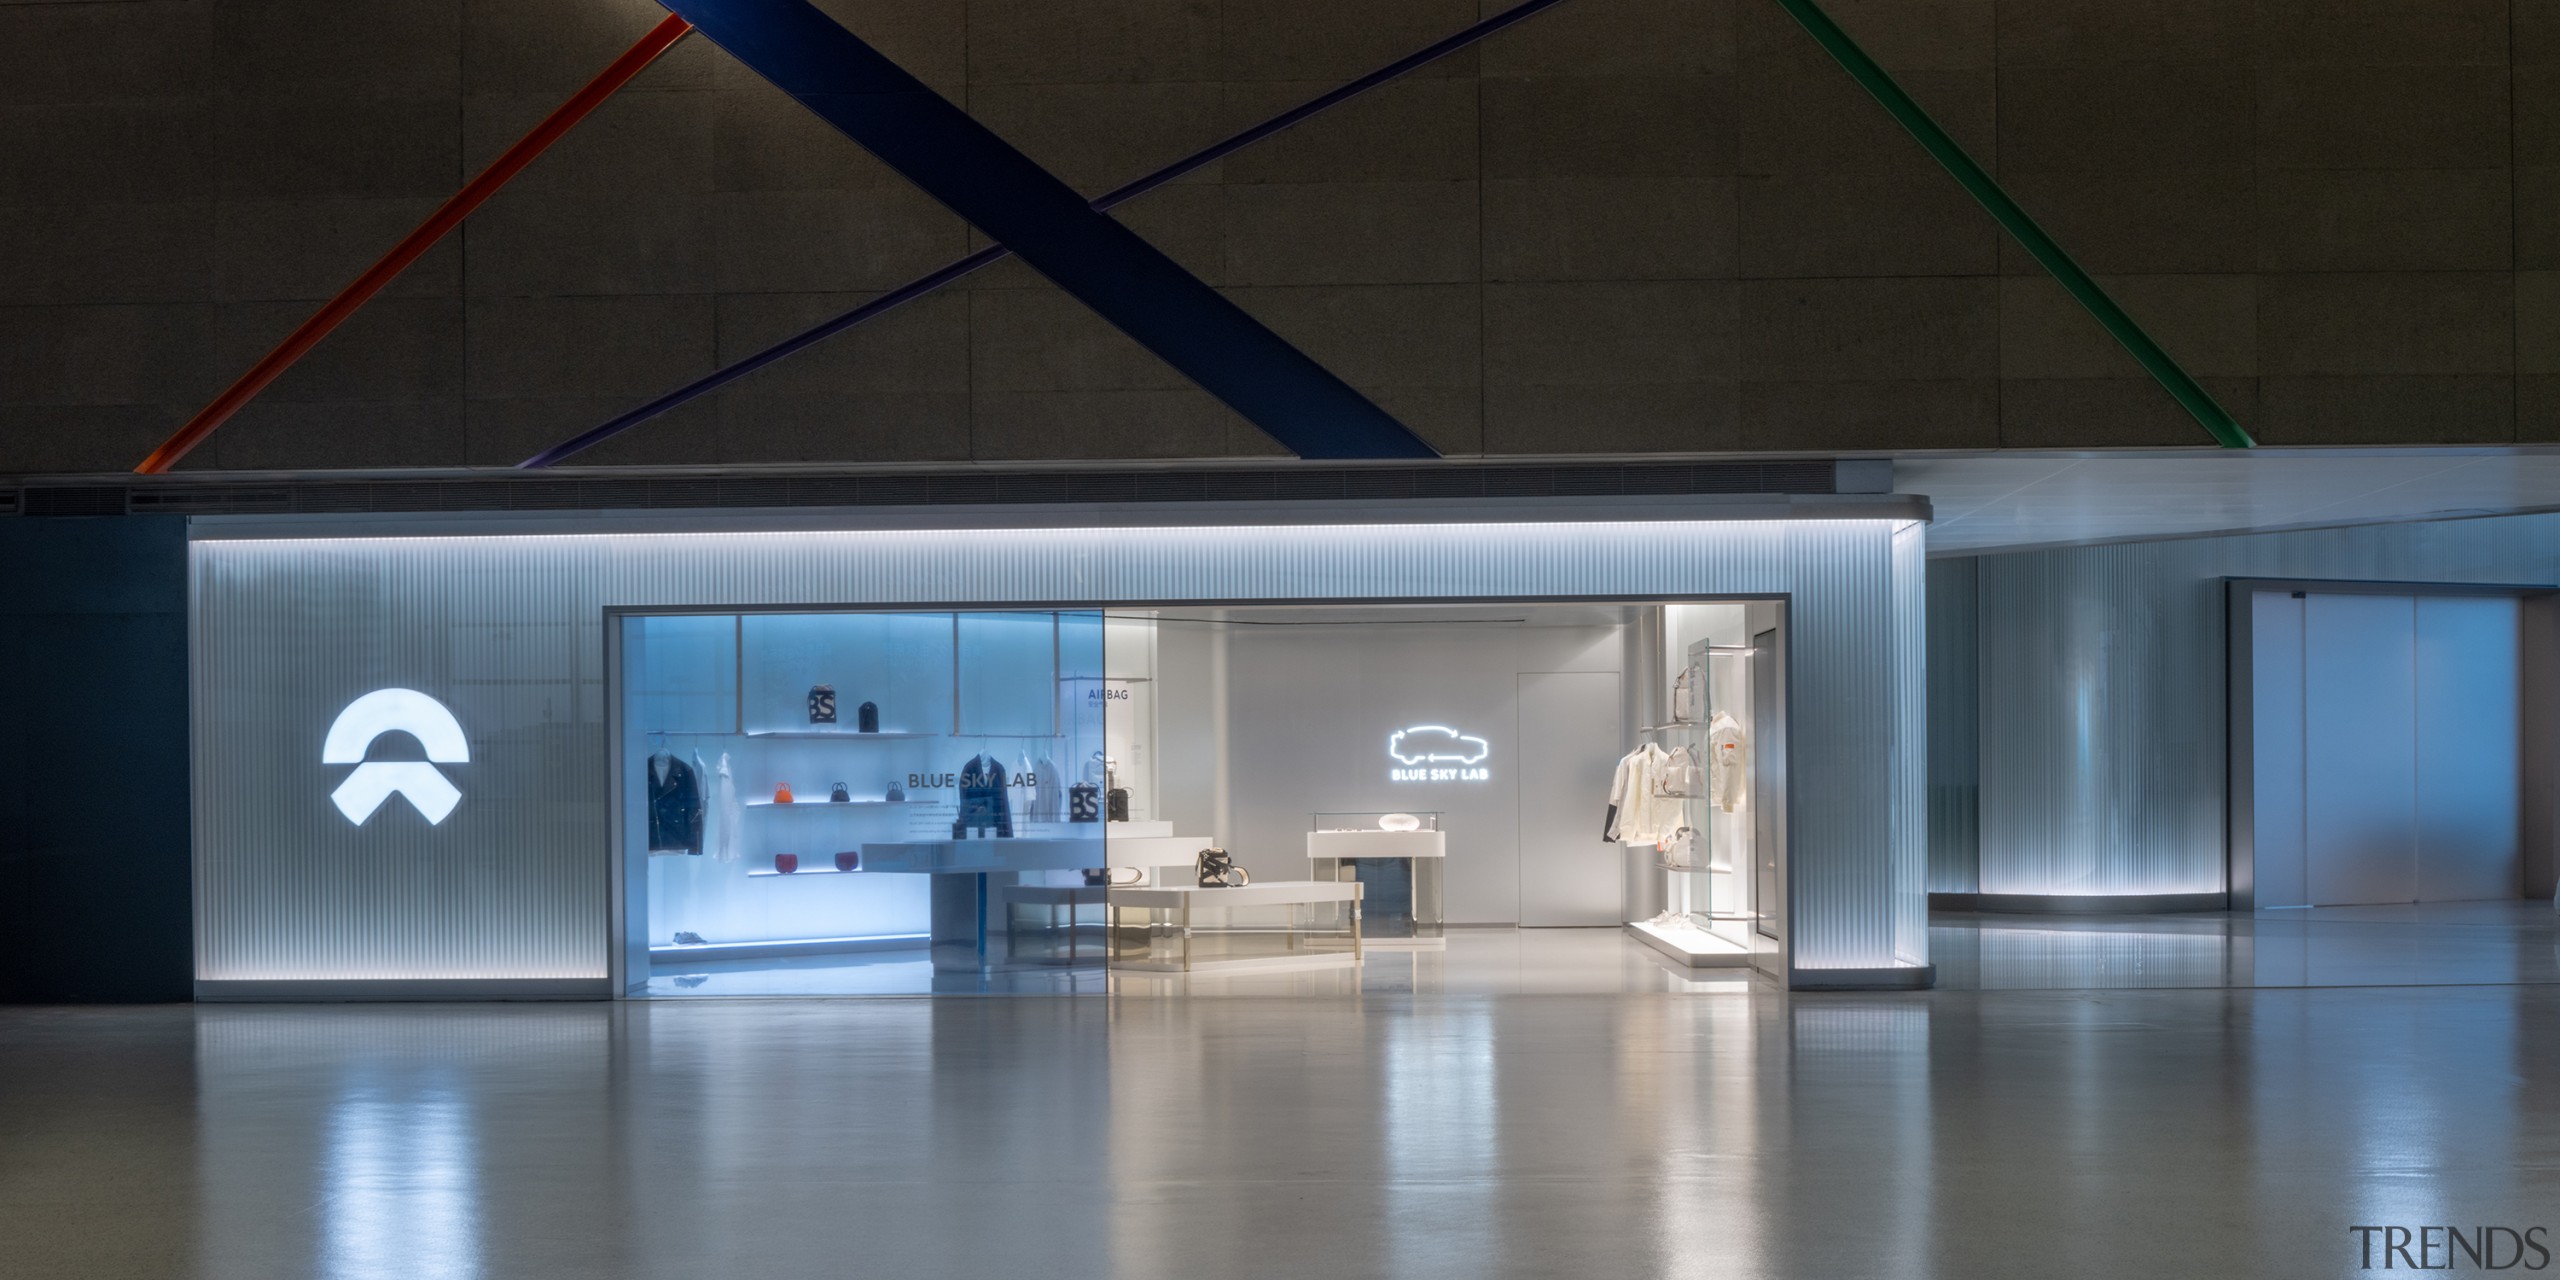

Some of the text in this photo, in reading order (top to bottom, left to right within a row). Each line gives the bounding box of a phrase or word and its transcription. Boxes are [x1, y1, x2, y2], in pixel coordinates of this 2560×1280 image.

[908, 773, 1037, 788] BLUE SKY LAB
[1392, 768, 1489, 781] BLUE SKY LAB
